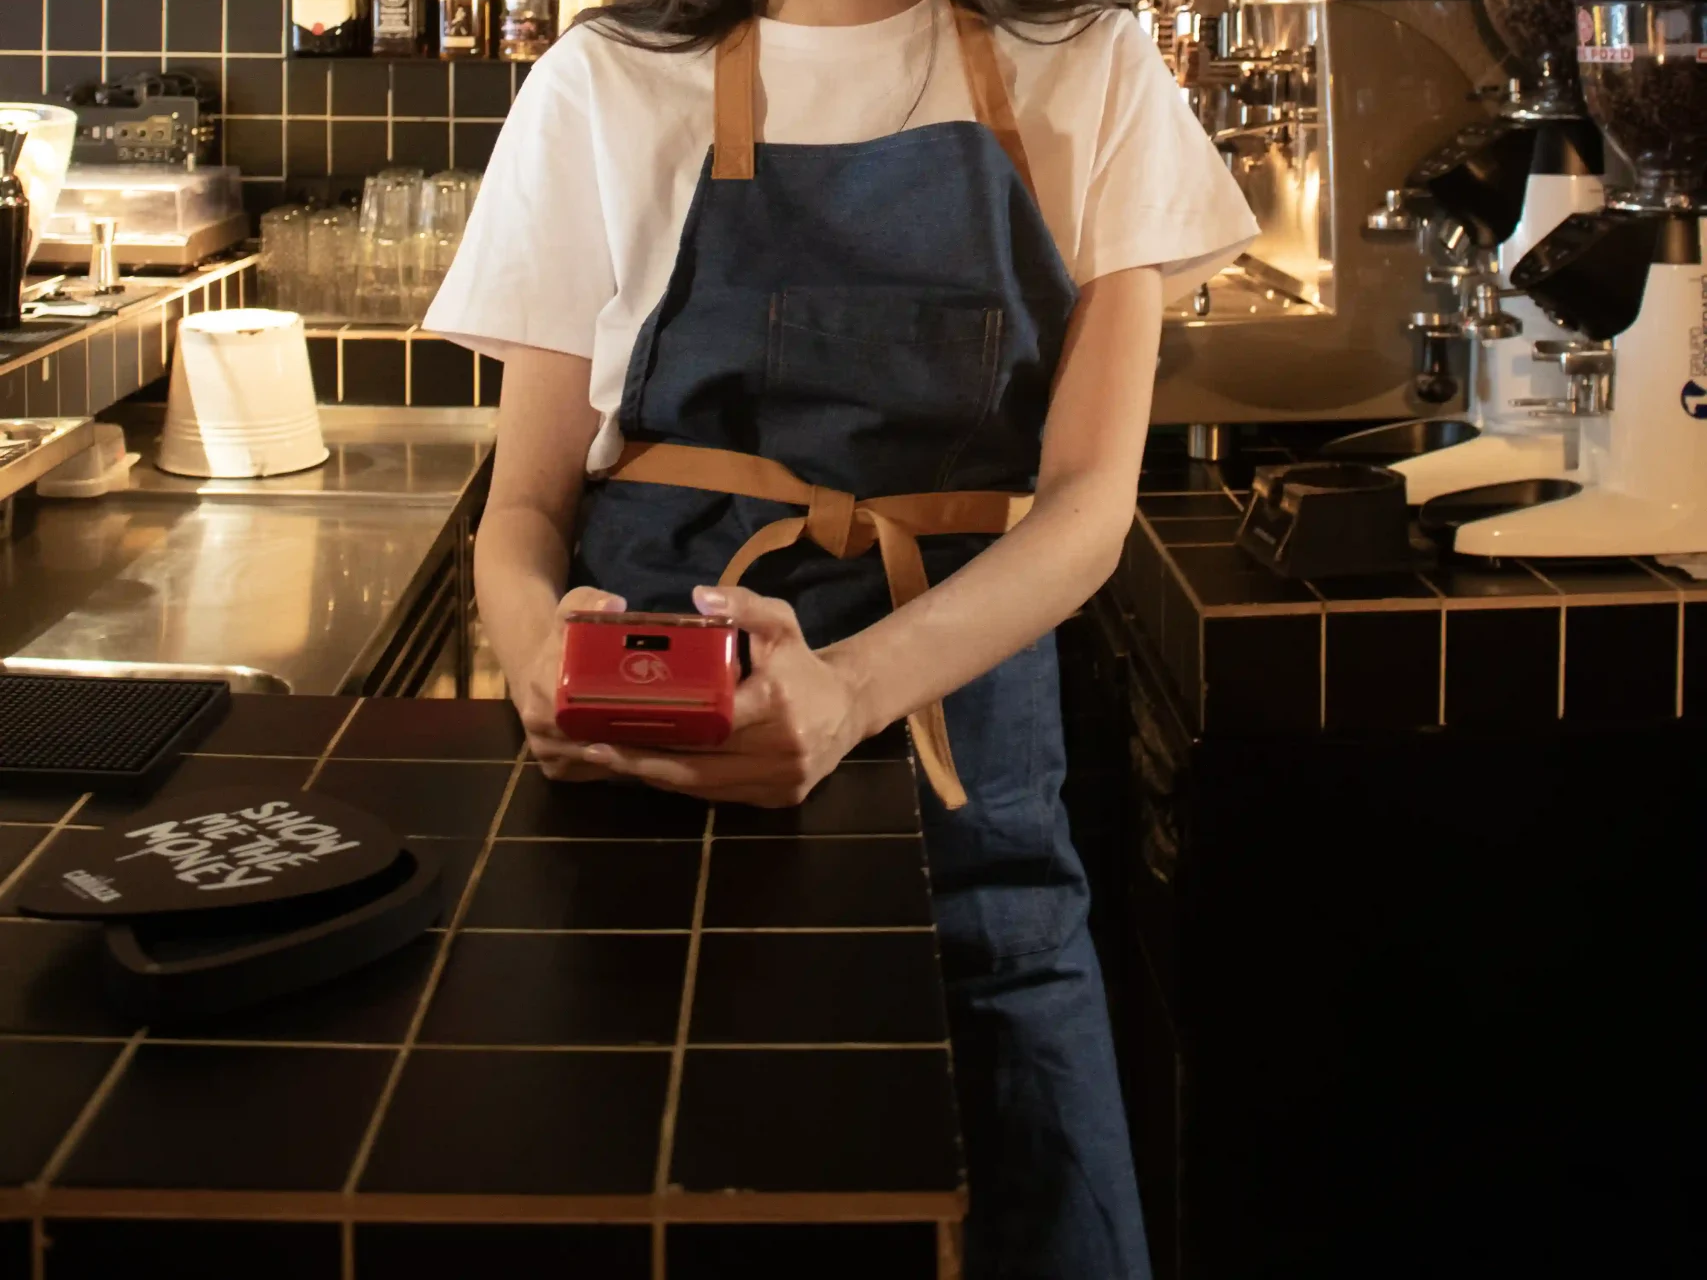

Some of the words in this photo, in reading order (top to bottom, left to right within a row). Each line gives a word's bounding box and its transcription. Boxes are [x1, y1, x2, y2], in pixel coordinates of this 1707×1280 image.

[115, 821, 273, 890] MONEY
[183, 813, 257, 840] ME
[229, 834, 319, 871] THE
[240, 801, 361, 856] SHOW
